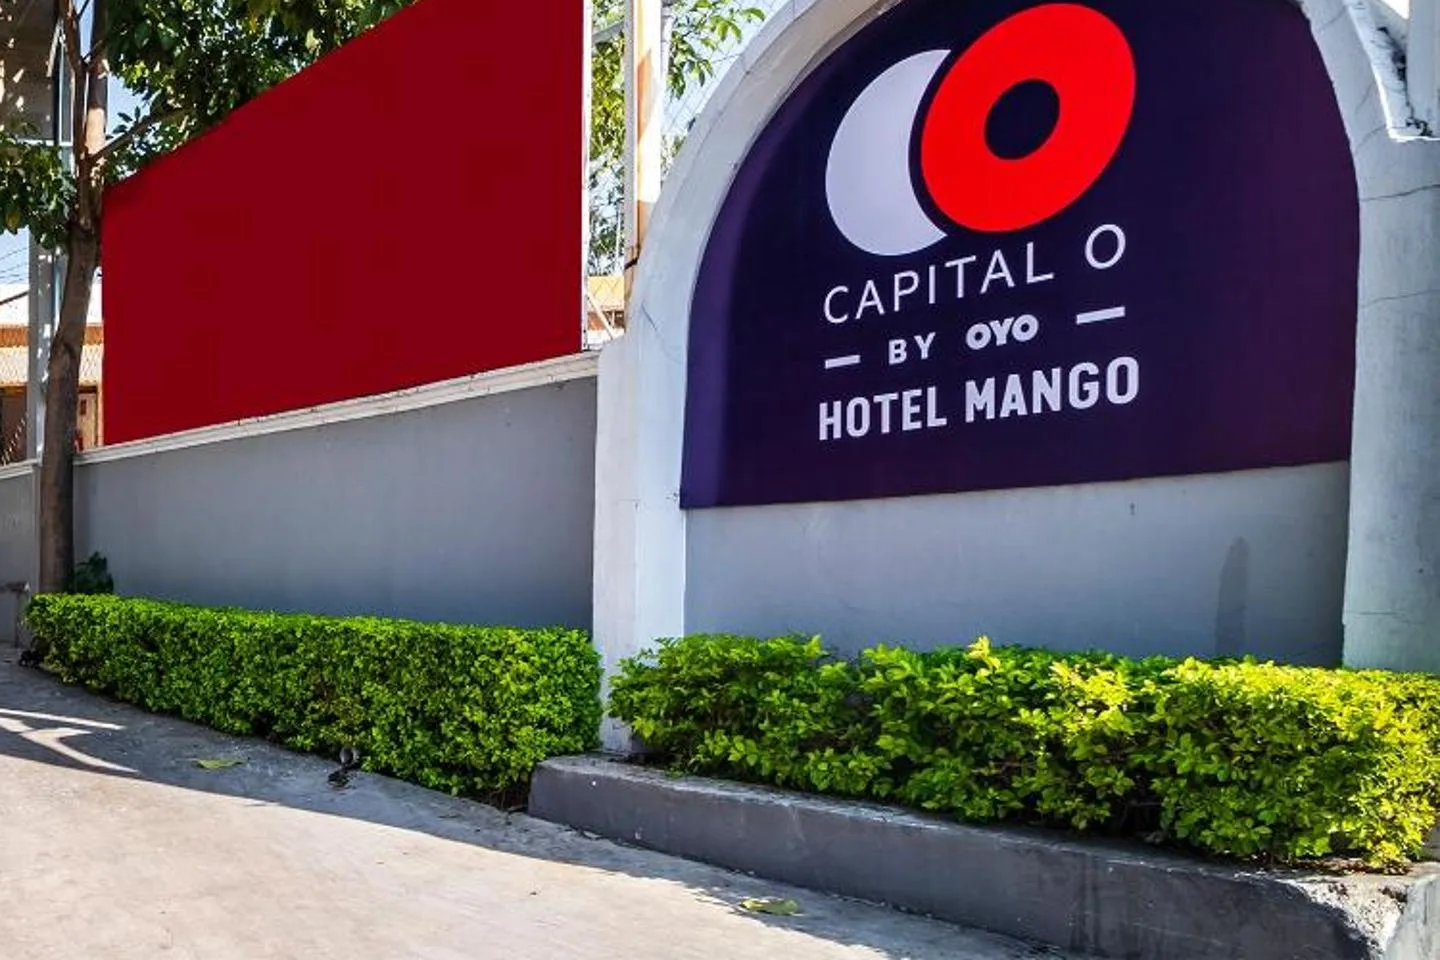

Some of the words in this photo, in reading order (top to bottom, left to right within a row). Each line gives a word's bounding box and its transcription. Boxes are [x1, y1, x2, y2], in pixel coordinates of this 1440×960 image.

[823, 241, 1055, 325] CAPITAL
[1084, 223, 1127, 270] O
[888, 332, 936, 366] BY
[965, 313, 1039, 350] OYO
[818, 386, 948, 441] HOTEL
[964, 355, 1141, 424] MANGO
